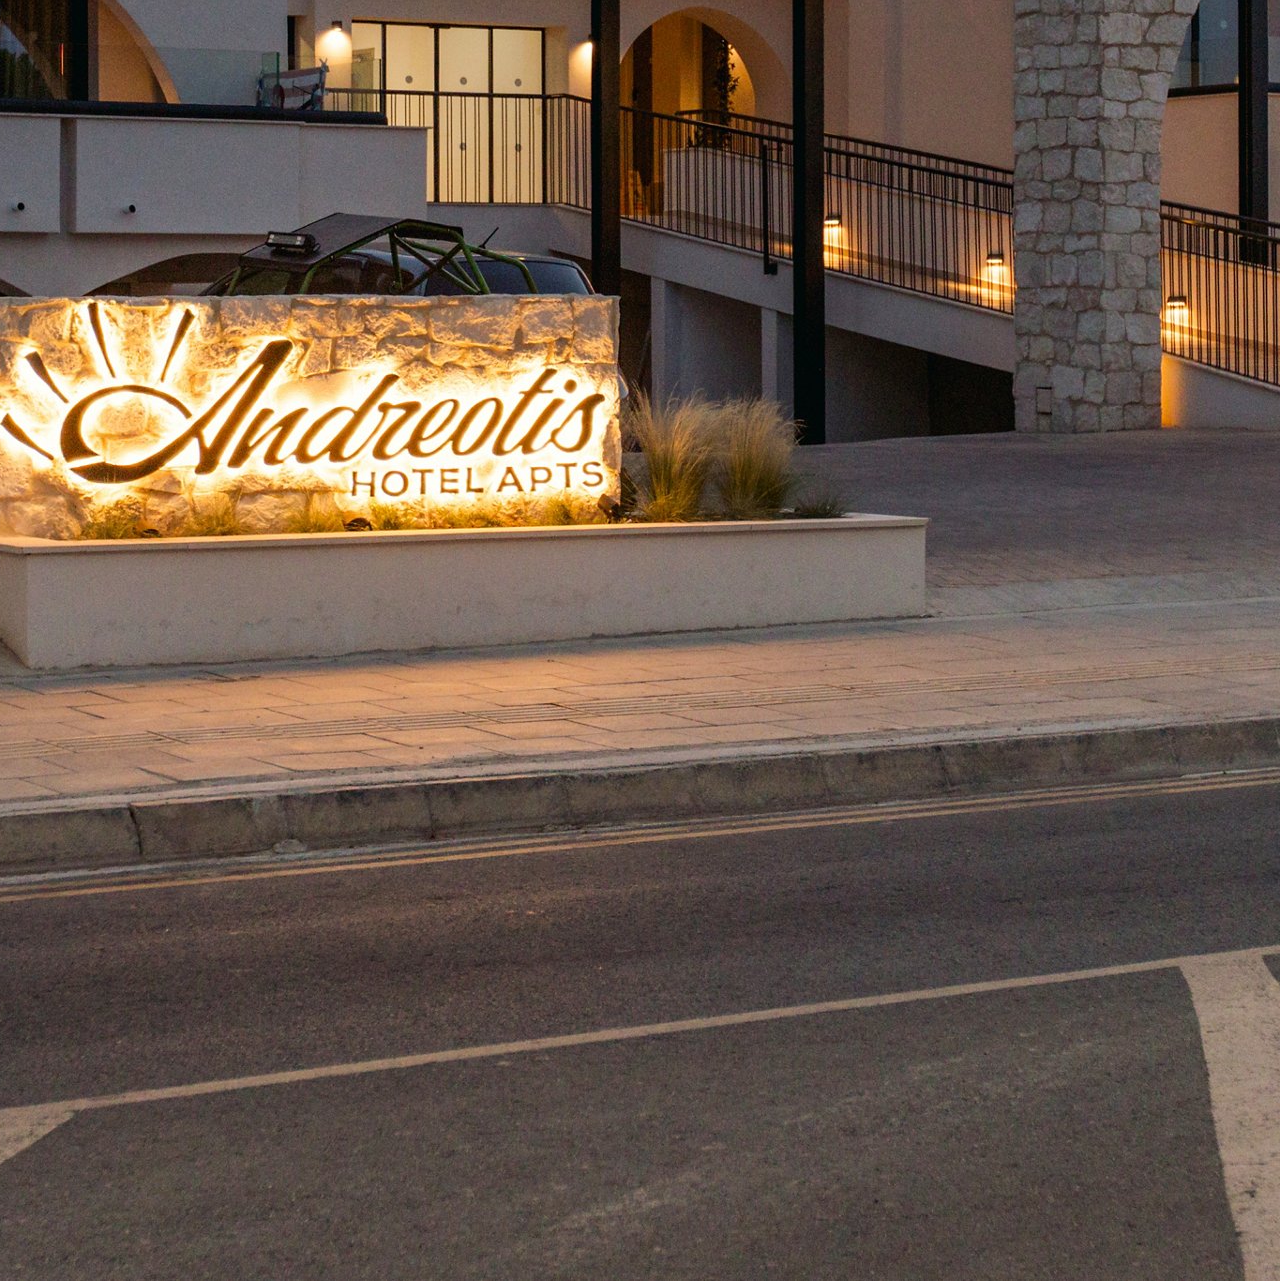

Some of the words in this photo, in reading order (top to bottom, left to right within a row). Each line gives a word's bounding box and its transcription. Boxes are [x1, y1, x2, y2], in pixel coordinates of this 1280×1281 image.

[60, 338, 605, 484] Andreotis
[351, 467, 484, 497] HOTEL
[496, 461, 604, 492] APTS
